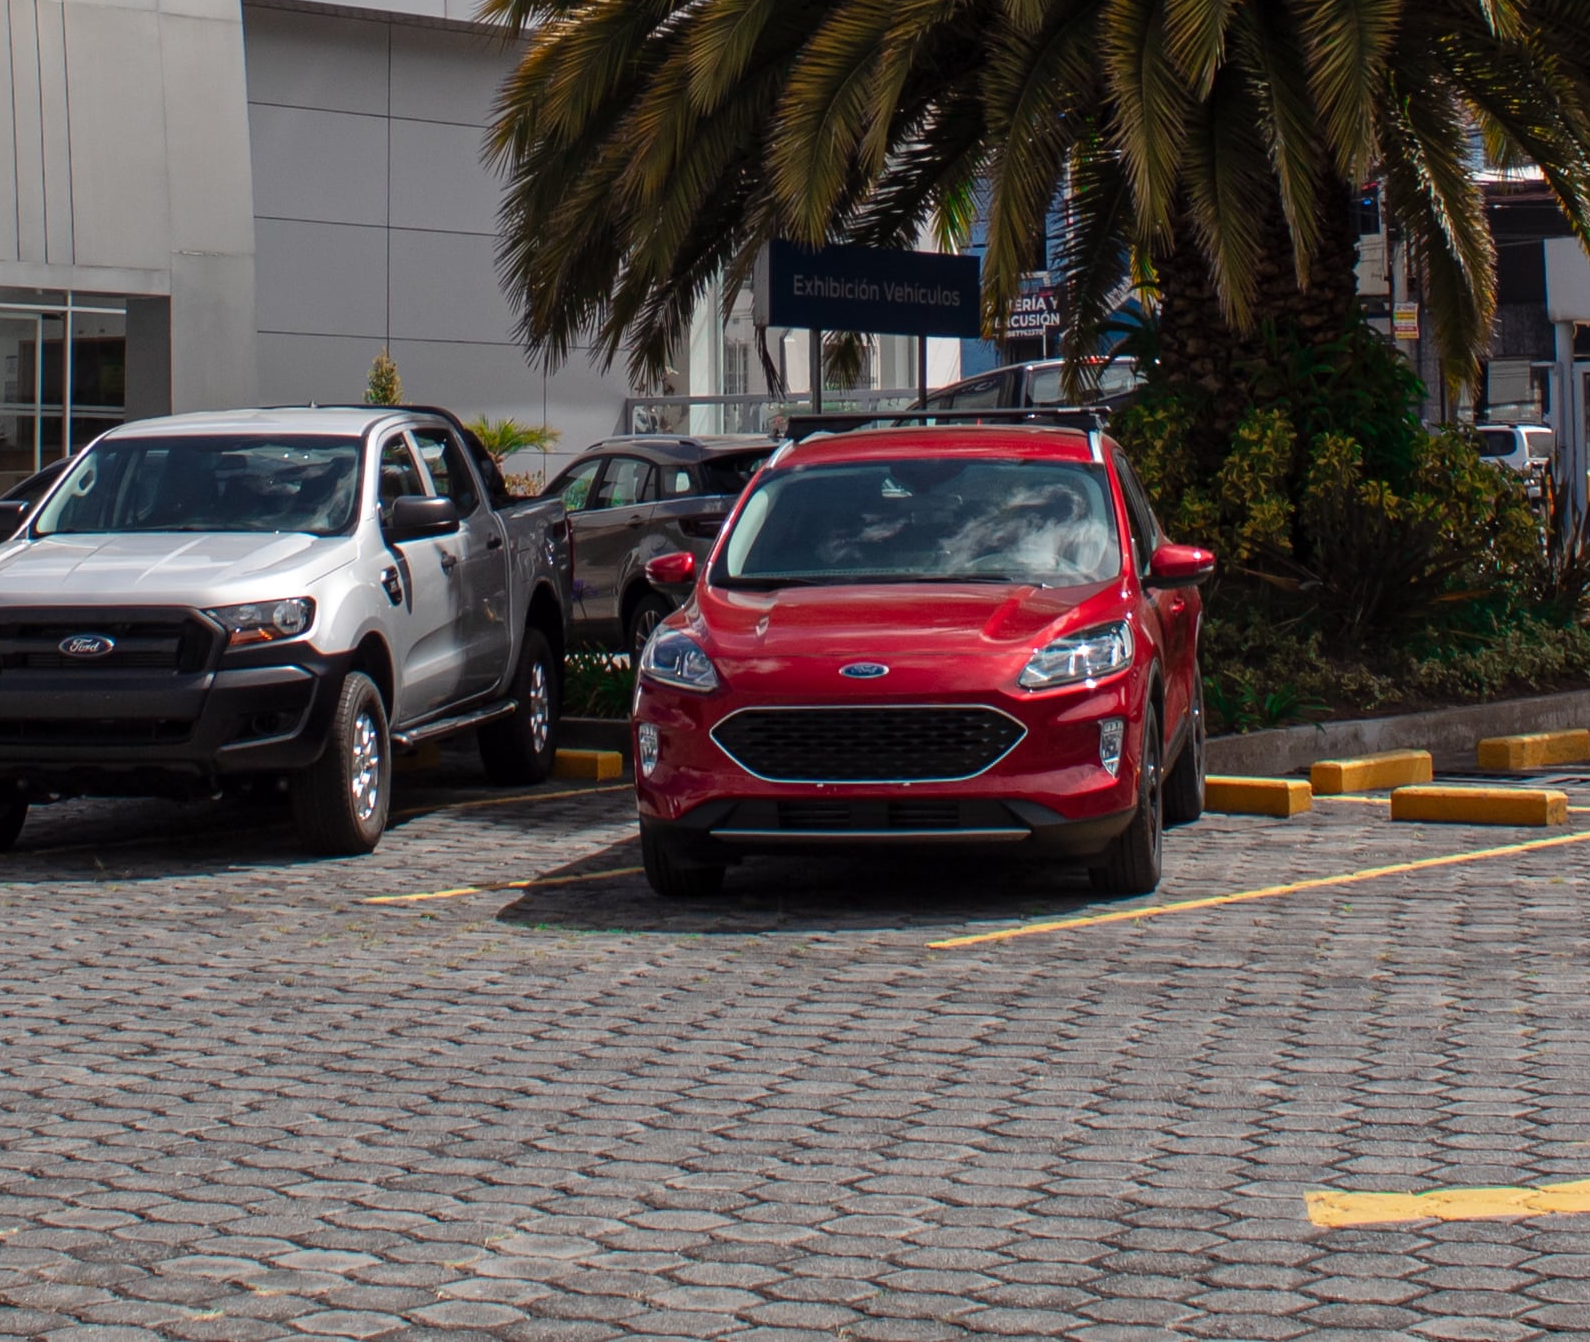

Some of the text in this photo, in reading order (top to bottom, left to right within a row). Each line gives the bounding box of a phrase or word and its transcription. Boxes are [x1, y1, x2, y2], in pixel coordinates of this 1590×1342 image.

[793, 274, 961, 307] Exhibición Vehículos
[994, 310, 1061, 329] CUSIÓN
[69, 638, 101, 653] Ford
